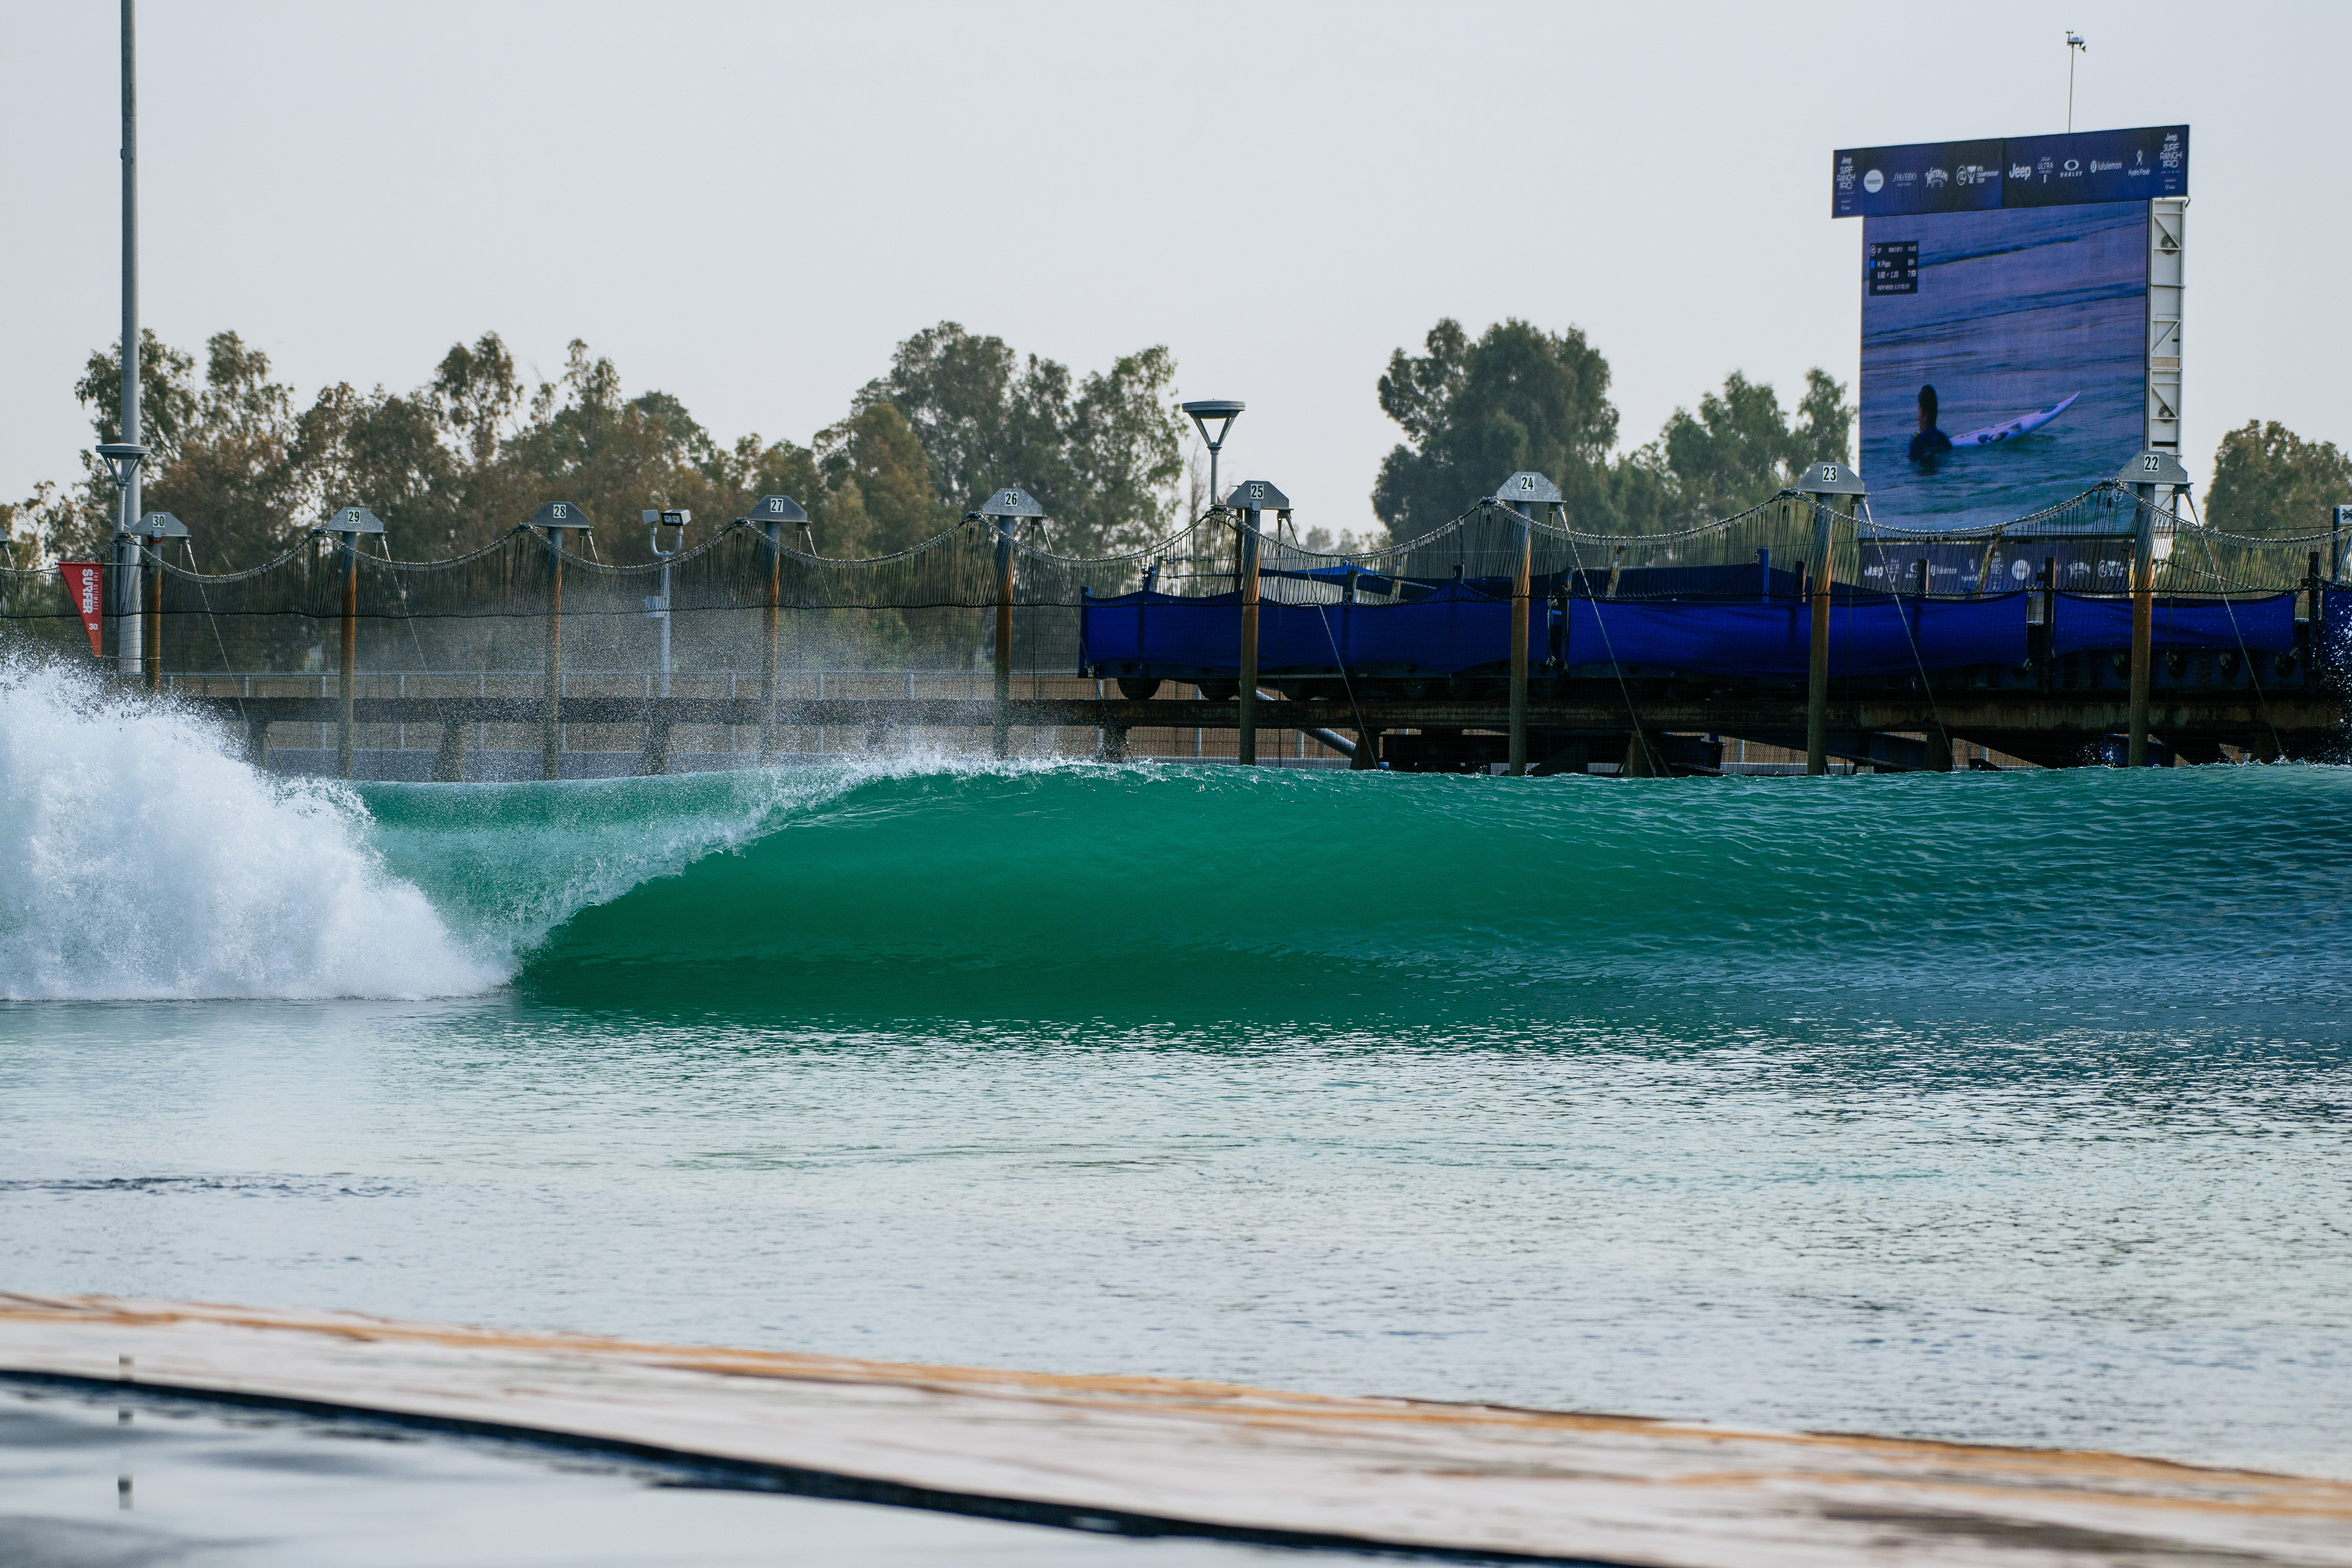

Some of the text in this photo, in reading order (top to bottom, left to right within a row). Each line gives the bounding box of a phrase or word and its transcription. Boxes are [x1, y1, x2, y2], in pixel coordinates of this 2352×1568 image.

[2165, 134, 2177, 142] Jeep
[2163, 143, 2179, 152] SURF
[2160, 151, 2182, 160] RANCH
[2097, 162, 2122, 170] lululemon
[2163, 160, 2179, 168] PRO
[2009, 164, 2031, 180] Jeep
[2128, 169, 2139, 178] Hydro
[1837, 174, 1855, 183] RANCH
[1892, 173, 1917, 183] SHISEIDO
[2144, 456, 2158, 470] 22
[1823, 466, 1836, 481] 23
[1521, 477, 1534, 491] 24
[1251, 485, 1263, 498] 25
[1005, 493, 1017, 505] 26
[771, 499, 783, 511] 27
[349, 511, 360, 522] 29
[554, 505, 565, 517] 28
[153, 515, 165, 526] 30
[82, 568, 93, 614] SURFER
